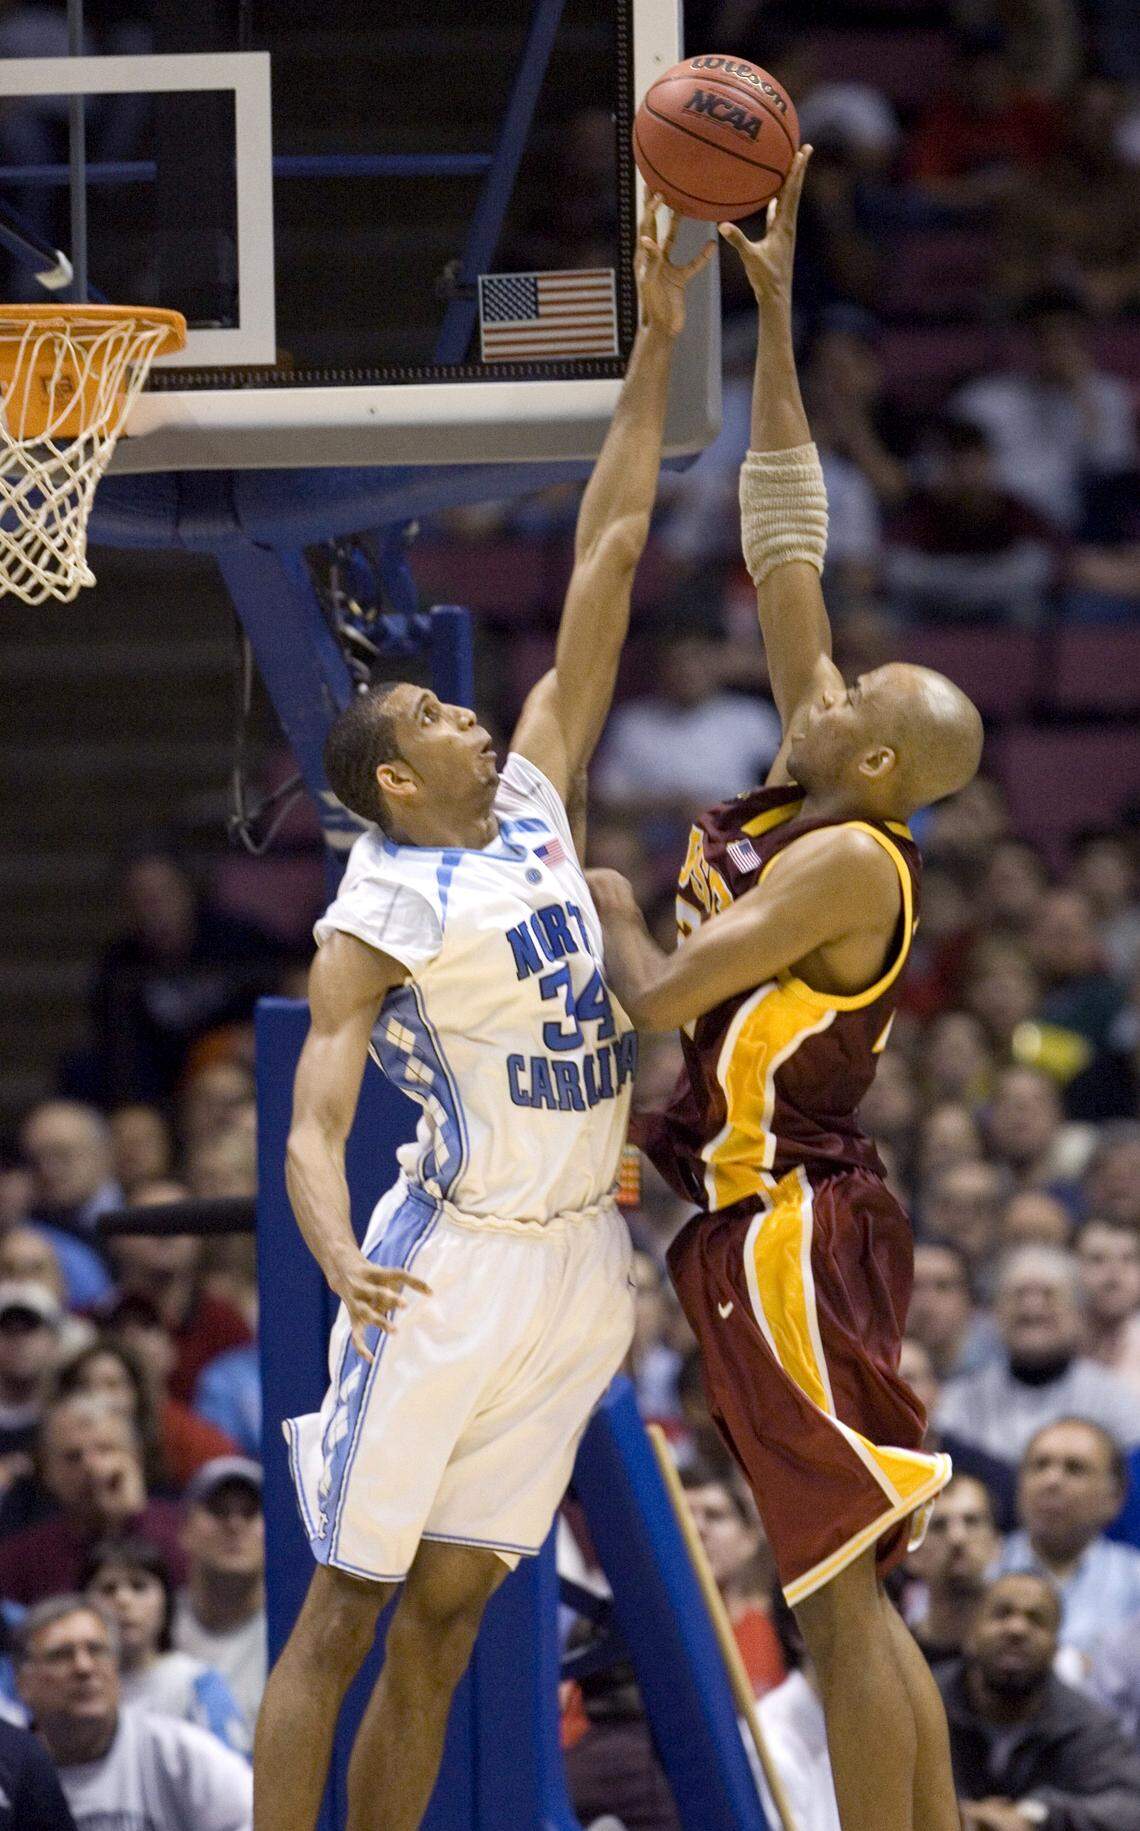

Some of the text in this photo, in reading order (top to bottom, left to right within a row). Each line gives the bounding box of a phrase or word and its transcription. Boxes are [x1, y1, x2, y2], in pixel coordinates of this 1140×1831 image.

[685, 88, 763, 140] NCAA
[690, 57, 787, 114] Wilson
[506, 901, 592, 981] NORT
[539, 961, 616, 1052] 34
